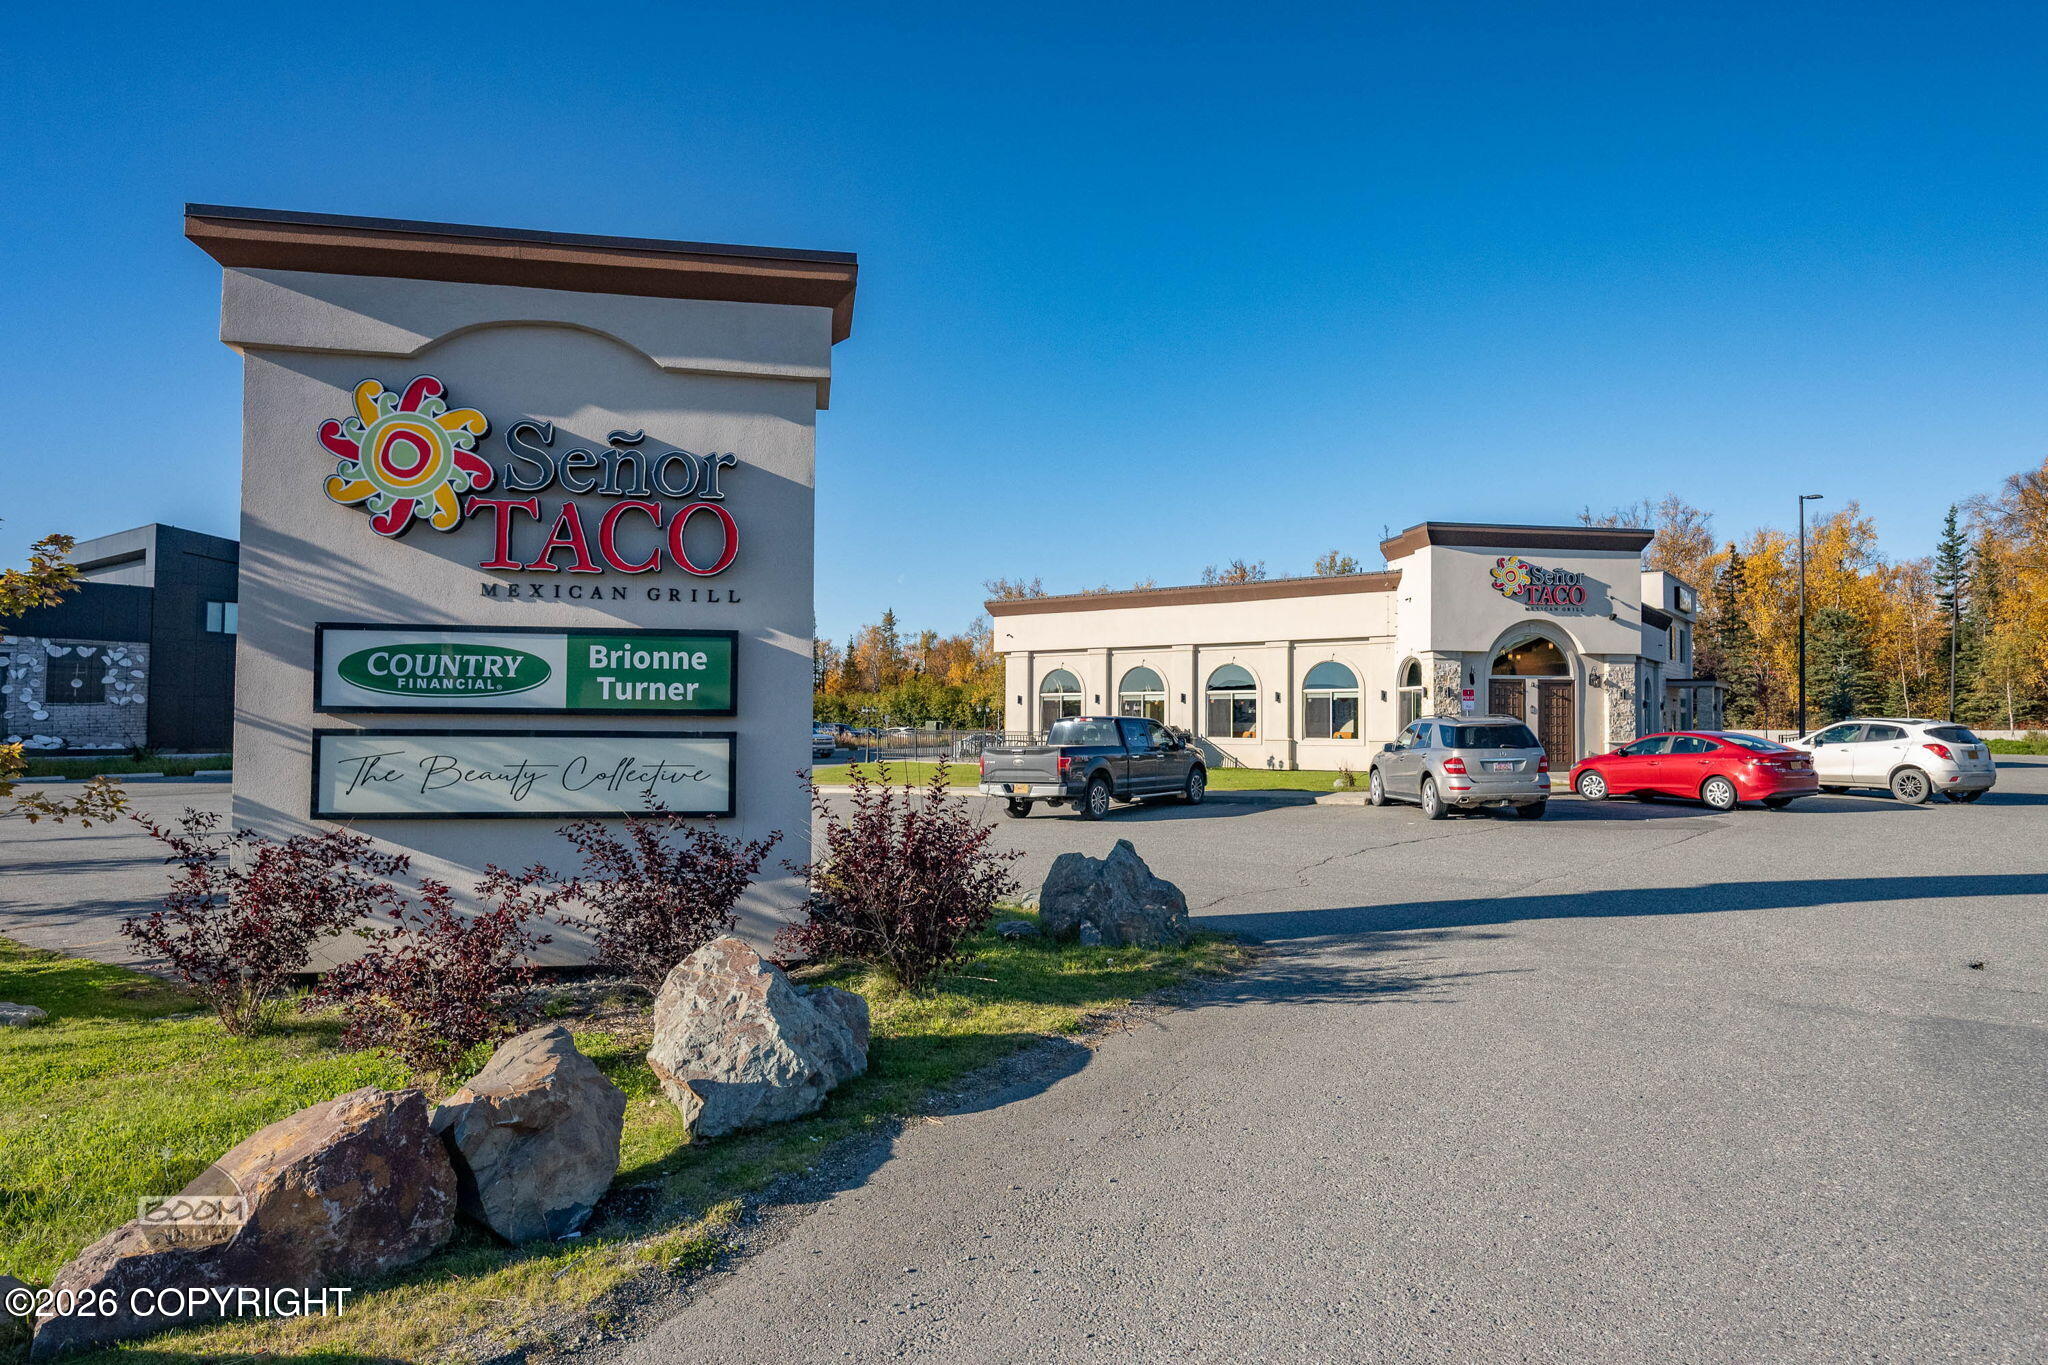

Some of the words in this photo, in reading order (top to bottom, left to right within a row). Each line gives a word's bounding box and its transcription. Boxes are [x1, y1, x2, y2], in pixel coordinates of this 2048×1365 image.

[504, 419, 738, 499] Señor
[465, 496, 741, 577] TACO
[1531, 566, 1585, 585] Señor
[481, 582, 627, 601] MEXICAN
[647, 587, 742, 604] GRILL
[1524, 585, 1587, 606] TACO
[367, 651, 524, 678] COUNTRY
[589, 643, 708, 671] Brionne
[596, 676, 700, 701] Turner
[338, 751, 405, 796] The
[419, 755, 559, 802] Beauty
[561, 756, 712, 794] Collective
